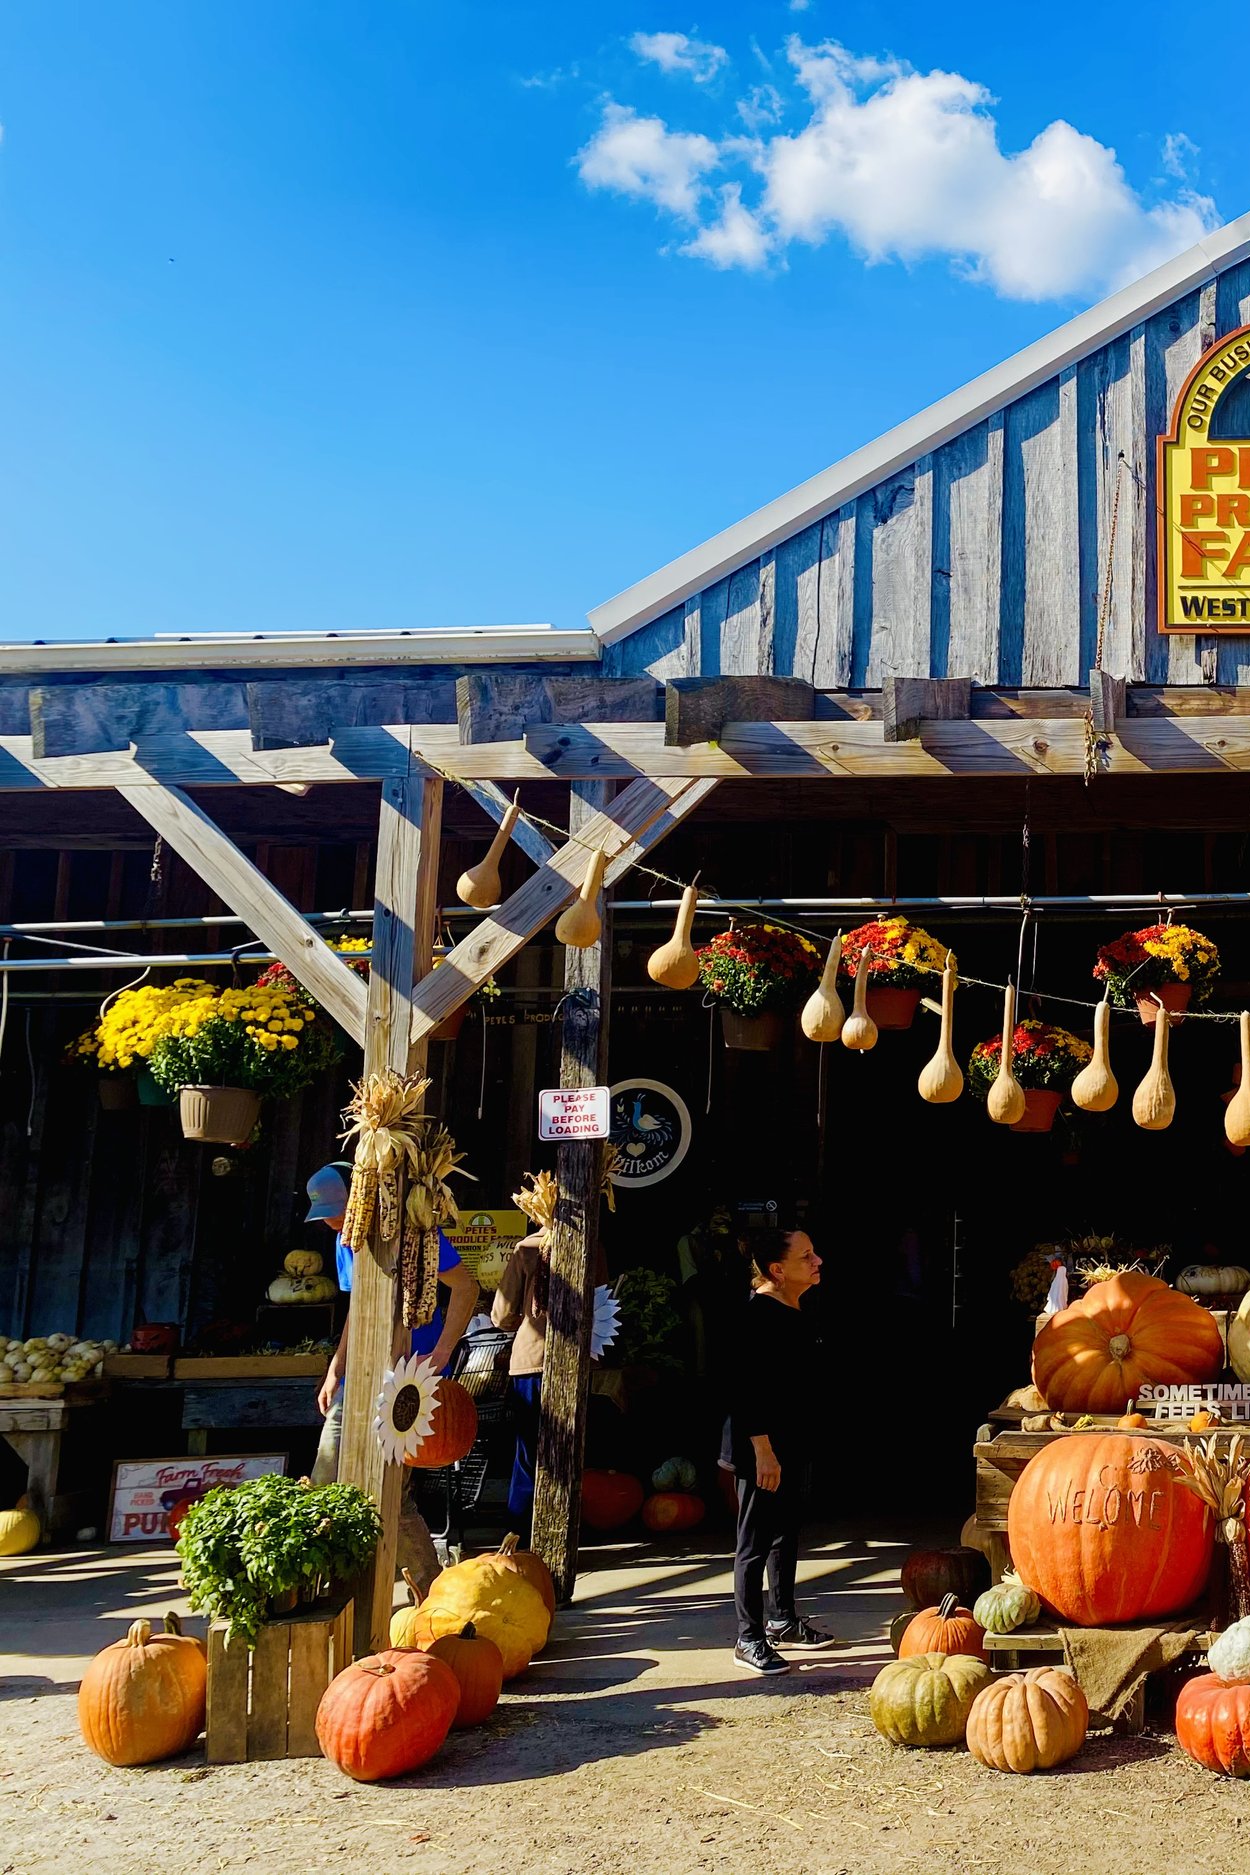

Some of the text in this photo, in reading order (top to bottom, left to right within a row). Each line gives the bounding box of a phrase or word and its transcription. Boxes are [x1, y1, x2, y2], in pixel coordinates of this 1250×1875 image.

[1187, 383, 1215, 429] OUR
[553, 1093, 596, 1103] PLEASE
[564, 1104, 585, 1113] PAY
[552, 1114, 596, 1124] BEFORE
[549, 1124, 599, 1135] LOADING
[444, 1235, 490, 1244] RODUCE
[1155, 1401, 1222, 1419] FEELS
[156, 1462, 246, 1488] Farm Fresh
